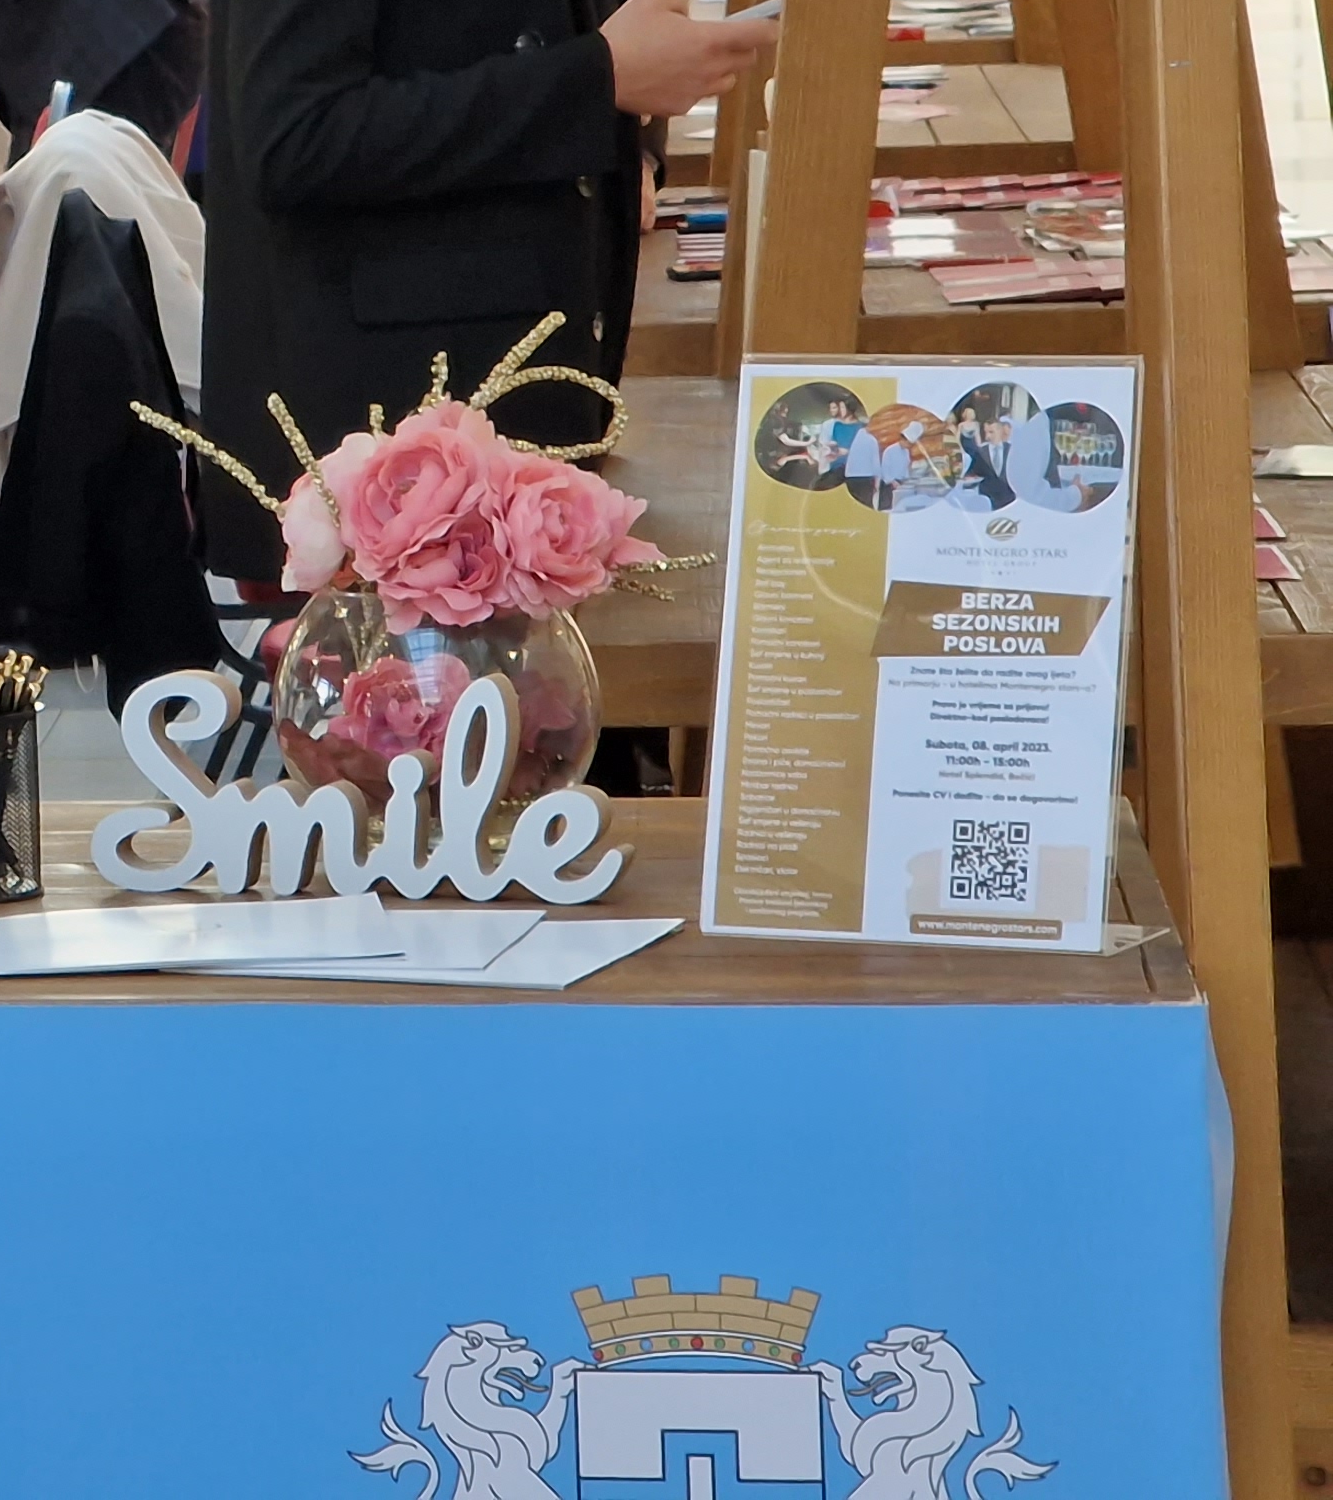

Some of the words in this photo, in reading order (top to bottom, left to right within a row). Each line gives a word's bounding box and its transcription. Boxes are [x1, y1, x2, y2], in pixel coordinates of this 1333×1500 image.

[936, 546, 1028, 559] MONTENEGRO
[1033, 548, 1068, 559] STARS
[961, 592, 1034, 611] BERZA
[932, 613, 1060, 633] SEZONSKIH
[943, 635, 1046, 654] POSLOVA
[993, 742, 1019, 753] april
[91, 670, 632, 905] Smile
